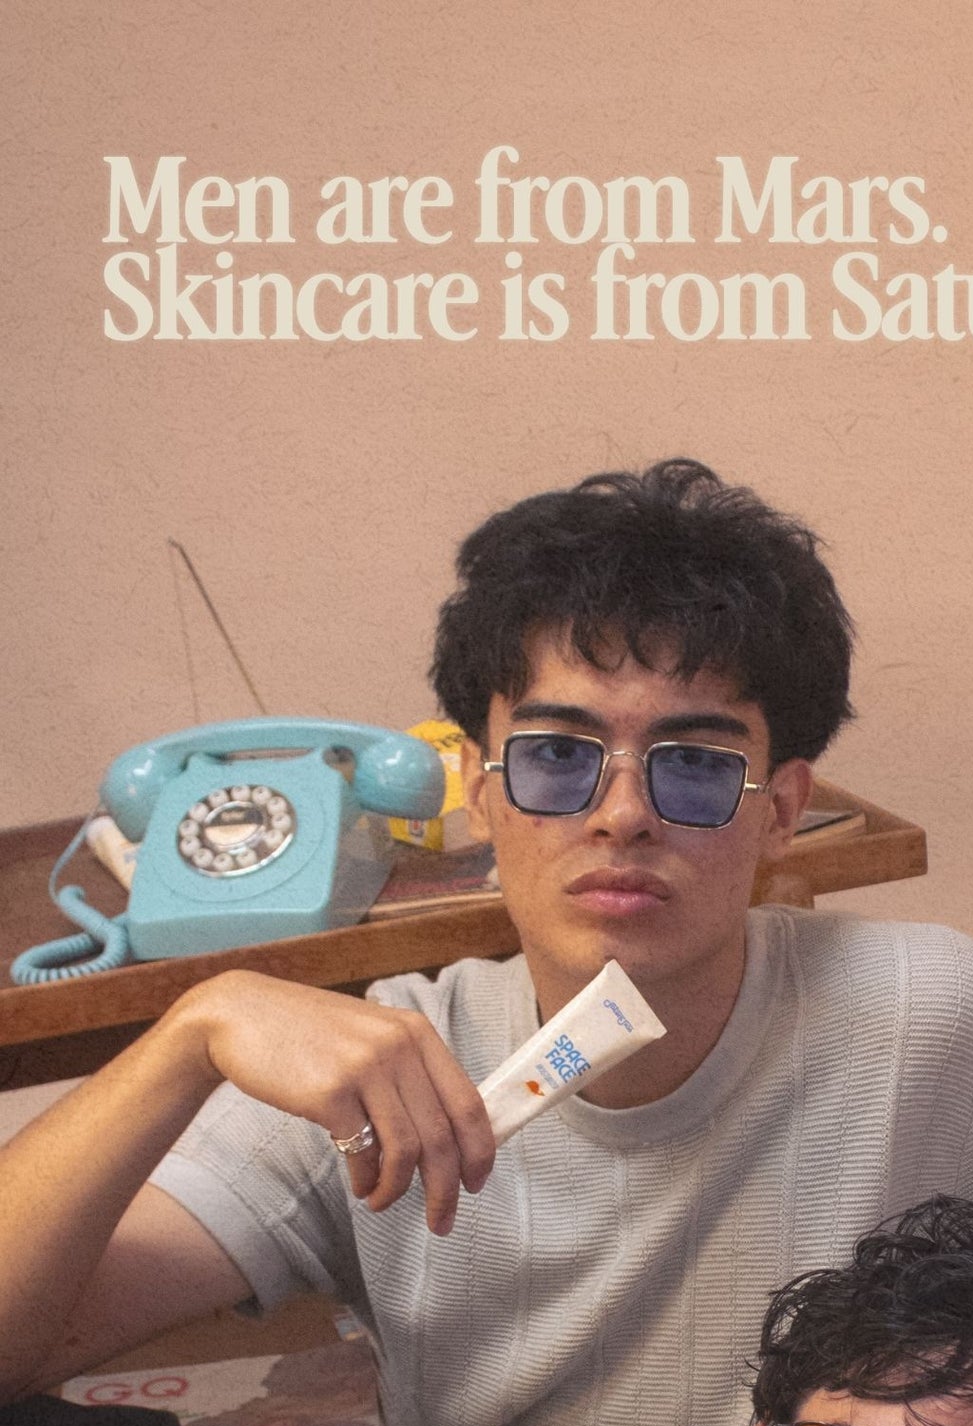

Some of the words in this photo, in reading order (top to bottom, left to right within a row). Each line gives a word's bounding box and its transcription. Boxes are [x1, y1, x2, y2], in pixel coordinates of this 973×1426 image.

[545, 1049, 576, 1084] FACE
[554, 1034, 591, 1077] SPACE
[85, 1376, 189, 1404] GQ
